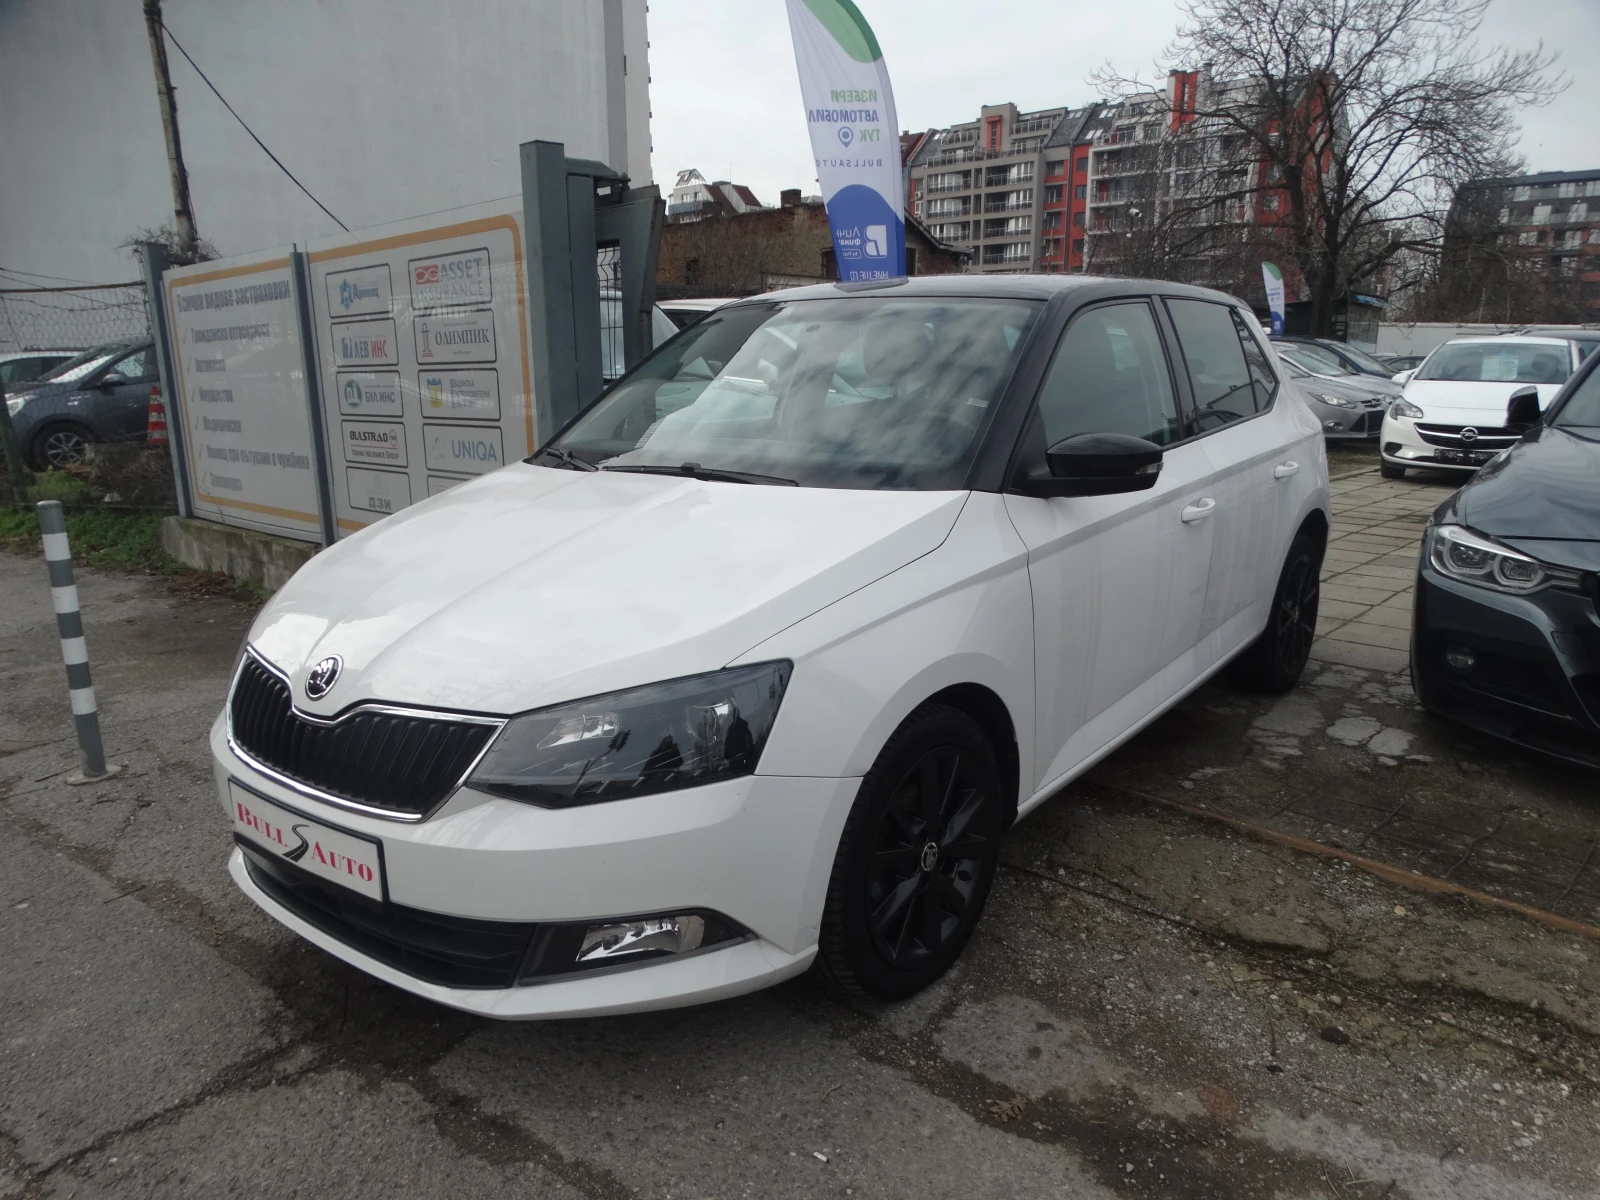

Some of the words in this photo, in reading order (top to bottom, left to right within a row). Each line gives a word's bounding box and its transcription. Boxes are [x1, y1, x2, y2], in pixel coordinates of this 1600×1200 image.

[440, 257, 483, 281] ASSET
[234, 280, 291, 306] застраховки
[416, 281, 484, 301] INSURANCE
[435, 328, 490, 346] ОЛИМПИК
[354, 340, 370, 359] ЛЕВ
[370, 339, 388, 359] ИНС
[364, 391, 380, 403] БУЛ
[379, 391, 396, 404] ИНС
[349, 430, 389, 443] BULSTRAD
[451, 439, 498, 462] UNIQA
[368, 496, 392, 511] ДЗИ
[311, 840, 373, 882] AUTO
